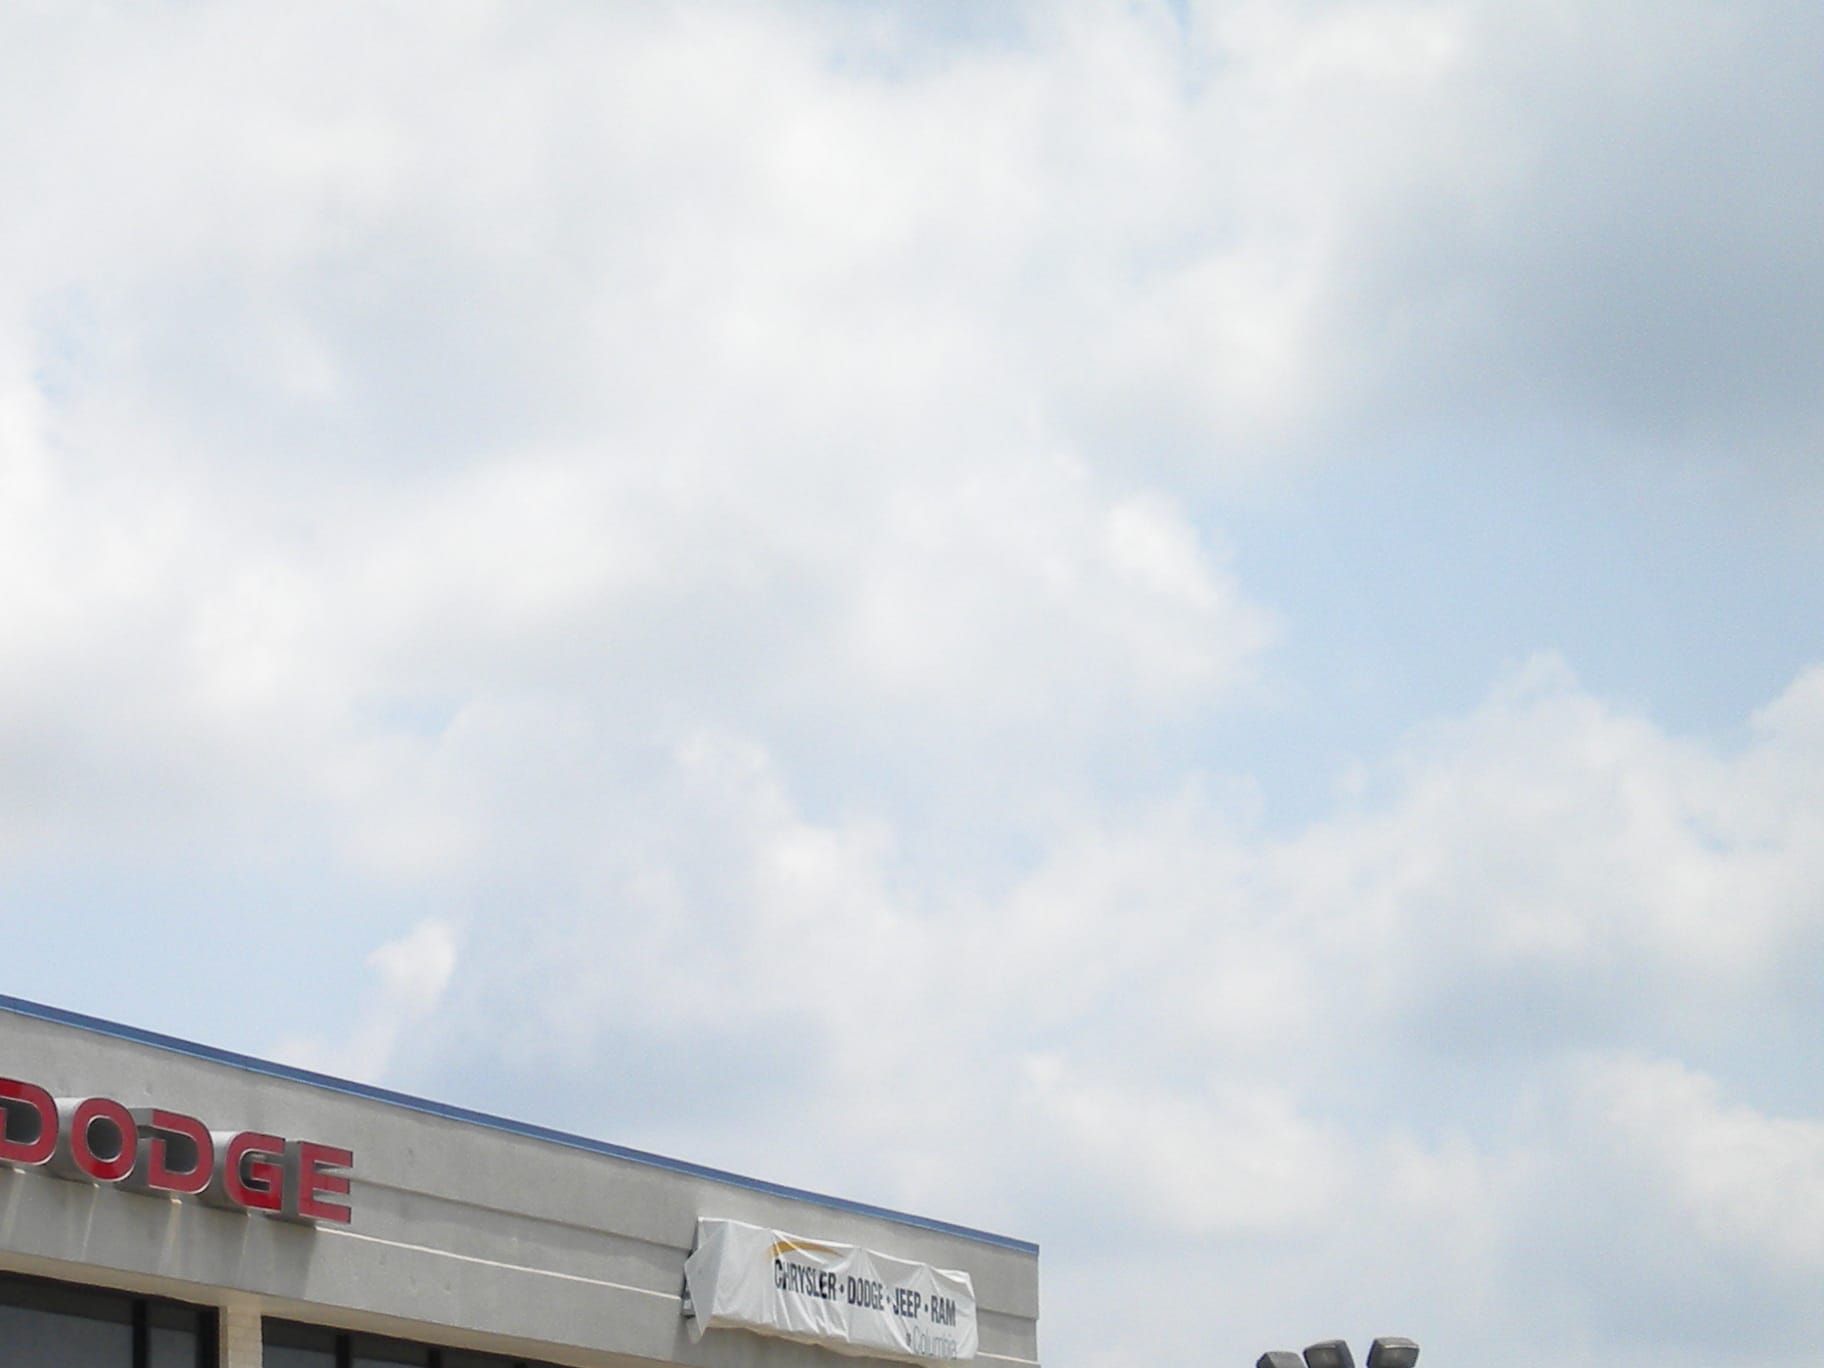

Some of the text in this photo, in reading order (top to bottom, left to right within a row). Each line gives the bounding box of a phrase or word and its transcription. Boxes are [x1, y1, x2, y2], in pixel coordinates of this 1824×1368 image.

[775, 1259, 956, 1327] CHRYSLER DODGE JEEP RAM
